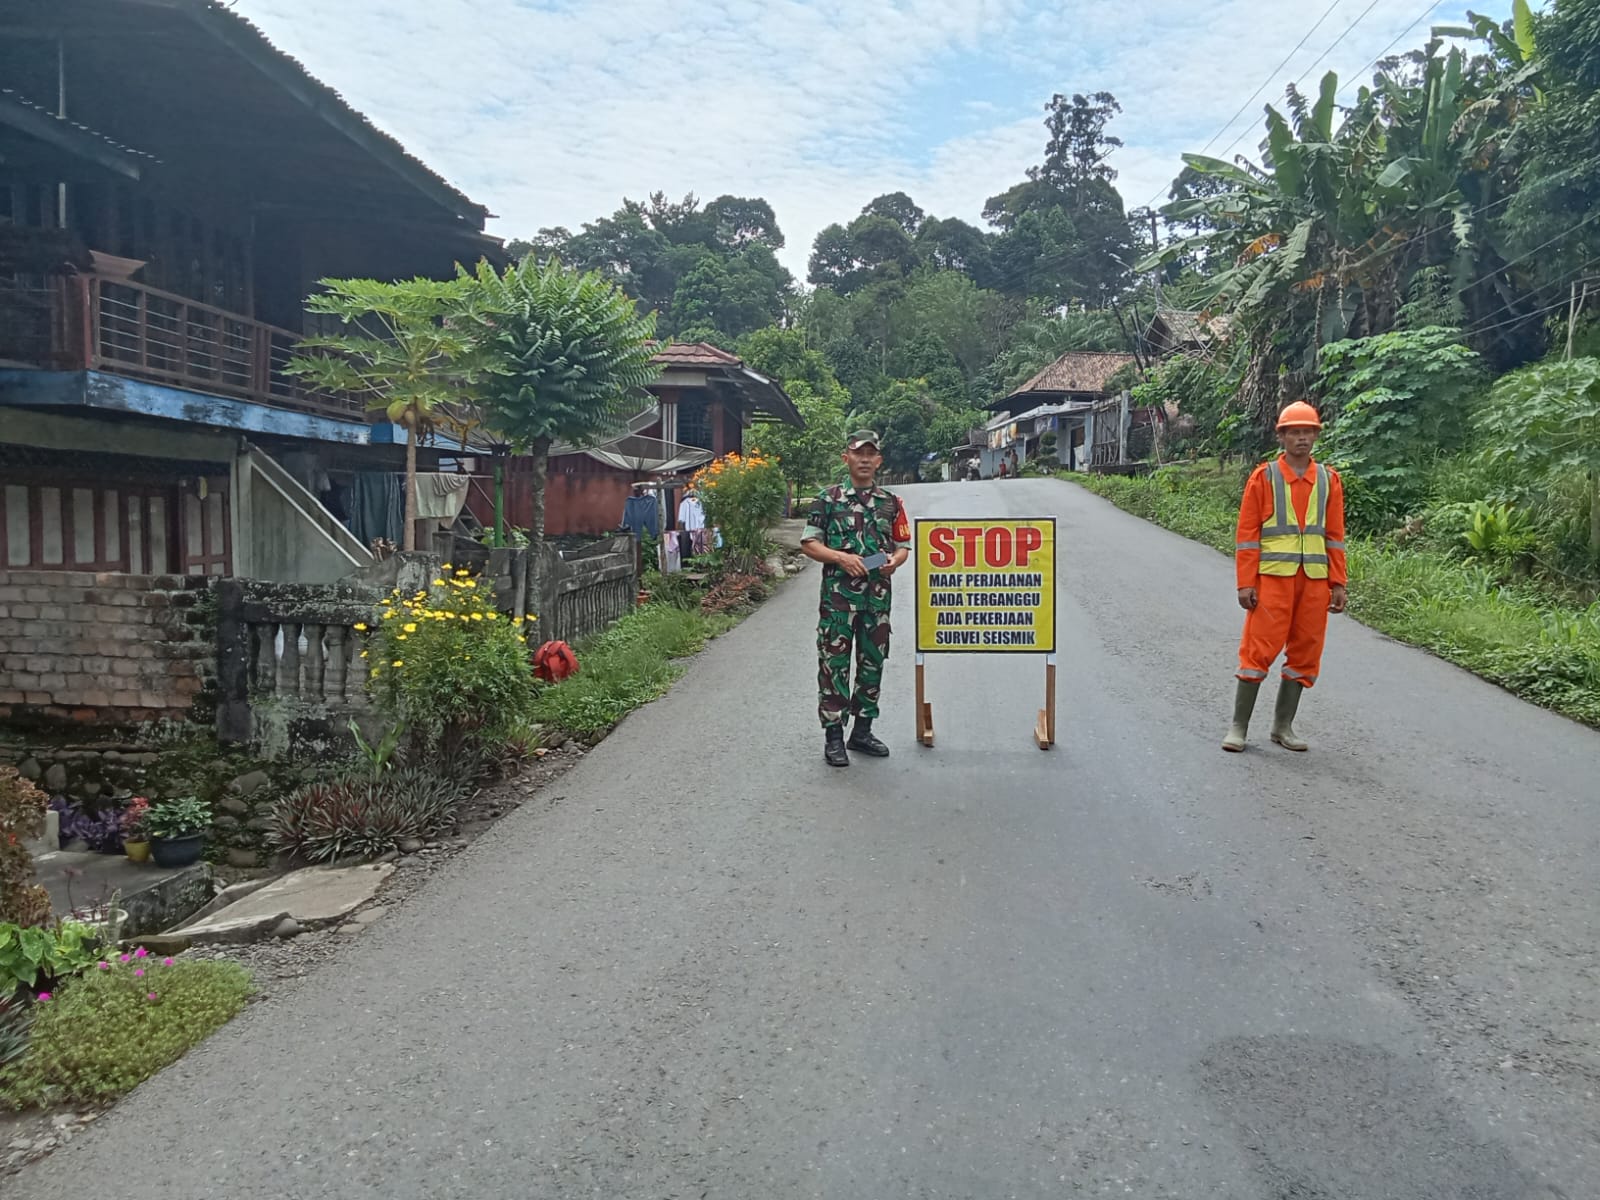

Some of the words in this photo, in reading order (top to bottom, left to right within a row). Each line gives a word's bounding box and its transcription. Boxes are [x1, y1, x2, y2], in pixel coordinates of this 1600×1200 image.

[928, 526, 1042, 568] STOP
[929, 574, 963, 587] MAAF
[966, 574, 1041, 587] PERJALANAN
[930, 593, 963, 606] ANDA
[966, 593, 1040, 606] TERGANGGU
[937, 612, 962, 625] ADA
[965, 612, 1033, 625] PEKERJAAN
[936, 631, 980, 644] SURVEI
[983, 631, 1035, 644] SEISMIK
